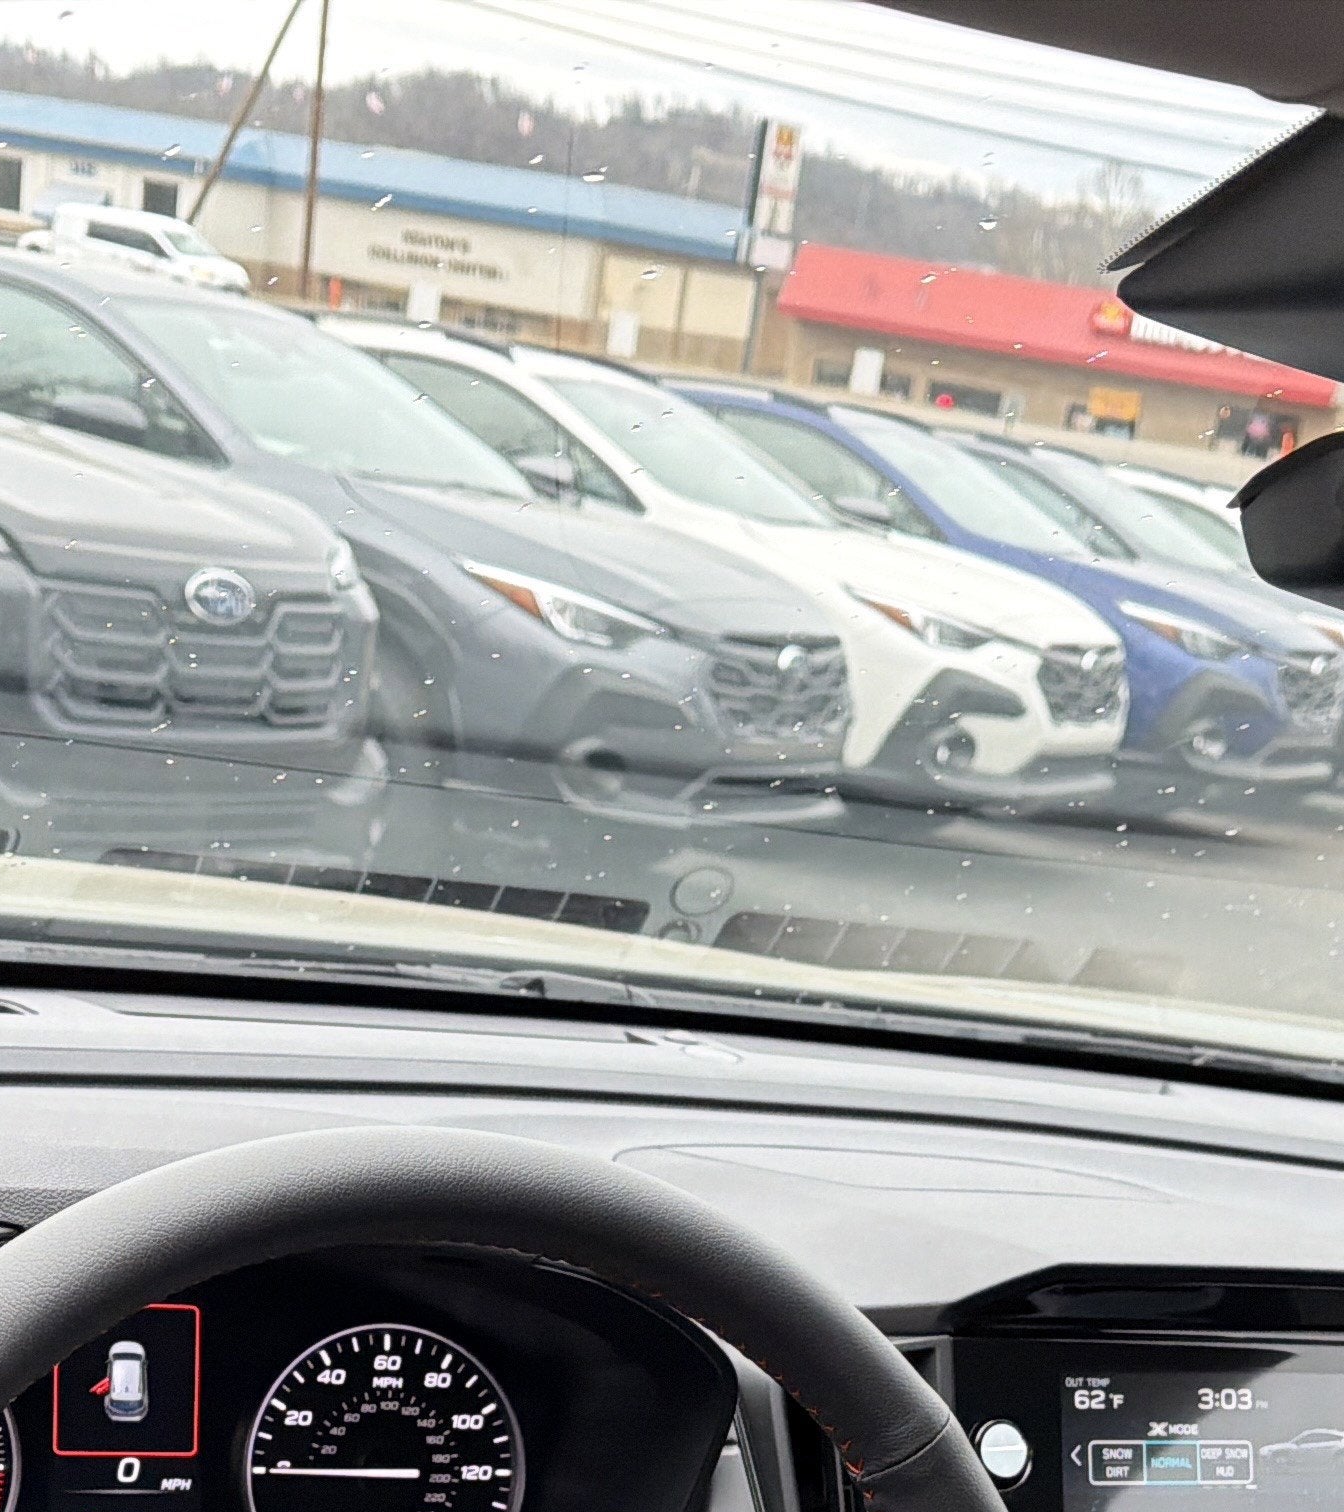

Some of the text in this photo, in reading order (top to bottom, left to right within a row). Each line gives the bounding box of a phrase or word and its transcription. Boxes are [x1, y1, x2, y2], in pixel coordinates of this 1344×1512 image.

[373, 1354, 402, 1371] 60
[316, 1368, 346, 1385] 40
[372, 1376, 403, 1389] MPH
[424, 1372, 452, 1389] 80
[1065, 1377, 1111, 1388] OUT TEMP
[1197, 1388, 1253, 1410] 3:03
[284, 1410, 313, 1426] 20
[451, 1414, 484, 1430] 100
[1102, 1448, 1133, 1461] SNOW
[1200, 1448, 1249, 1460] DEEP SNOW
[117, 1457, 141, 1483] 0
[1150, 1456, 1193, 1470] NORMAL
[461, 1465, 493, 1481] 120
[1105, 1465, 1130, 1478] DIRT
[1215, 1465, 1235, 1477] MUD
[160, 1478, 193, 1491] MPH
